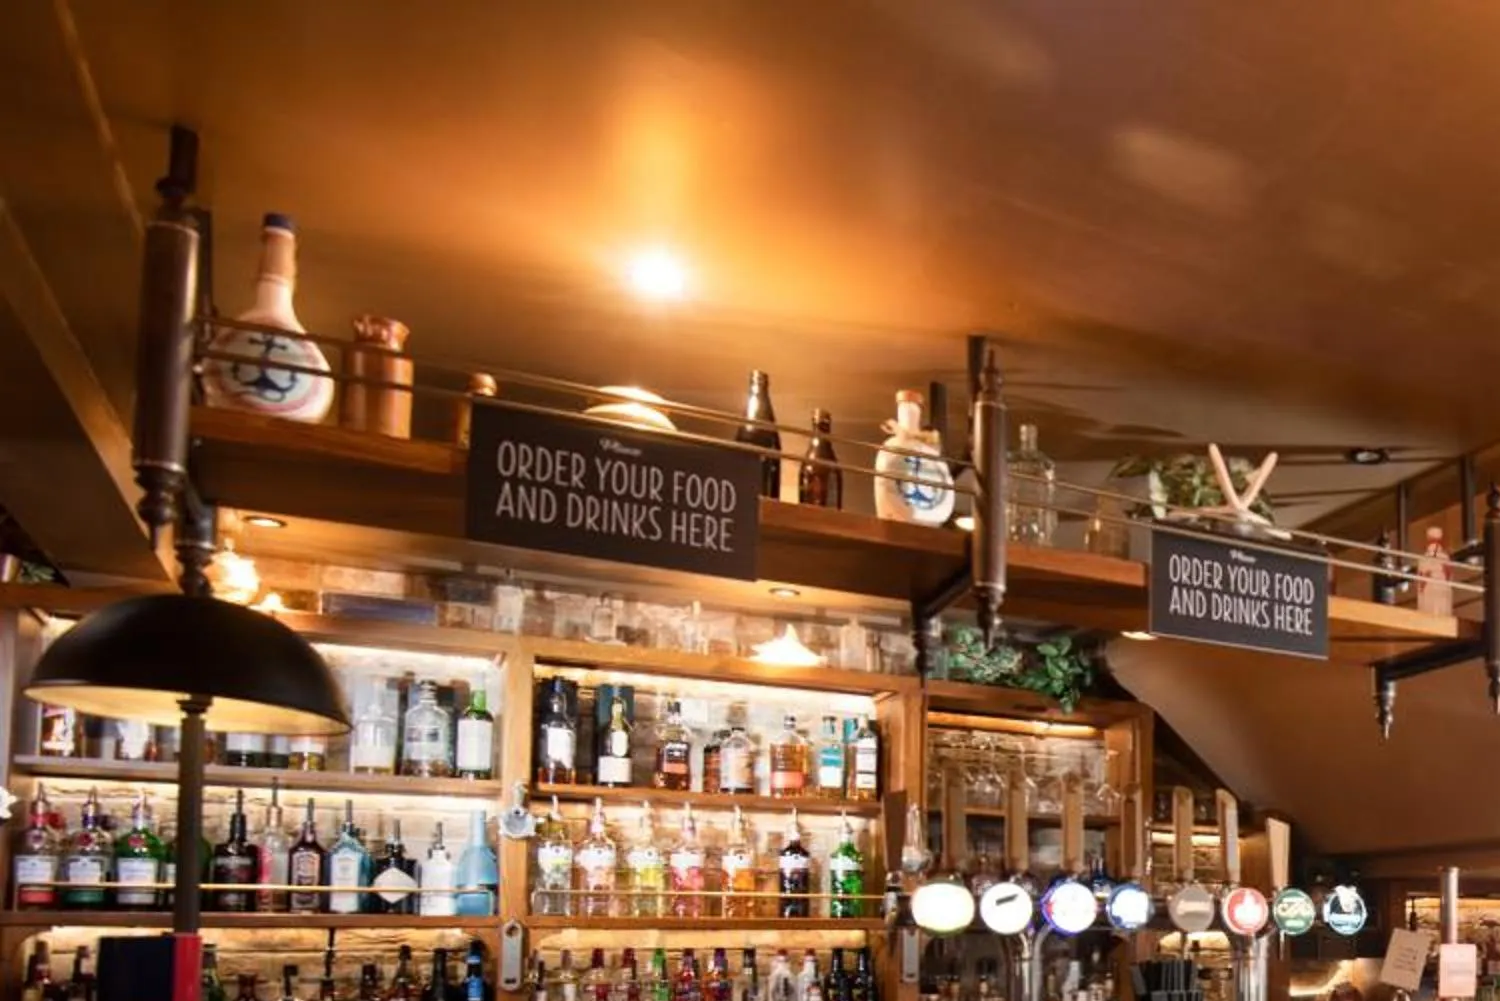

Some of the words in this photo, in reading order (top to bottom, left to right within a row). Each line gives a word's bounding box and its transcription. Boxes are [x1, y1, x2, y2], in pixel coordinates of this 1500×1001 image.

[496, 440, 586, 489] ORDER
[595, 456, 664, 502] YOUR
[672, 471, 737, 513] FOOD
[496, 482, 557, 523] AND
[566, 493, 662, 540] DRINKS
[671, 510, 735, 552] HERE
[1169, 553, 1223, 590] ORDER
[1227, 564, 1271, 599] YOUR
[1274, 572, 1315, 606] FOOD
[1169, 586, 1207, 619] AND
[1211, 592, 1271, 629] DRINKS
[1274, 604, 1313, 636] HERE
